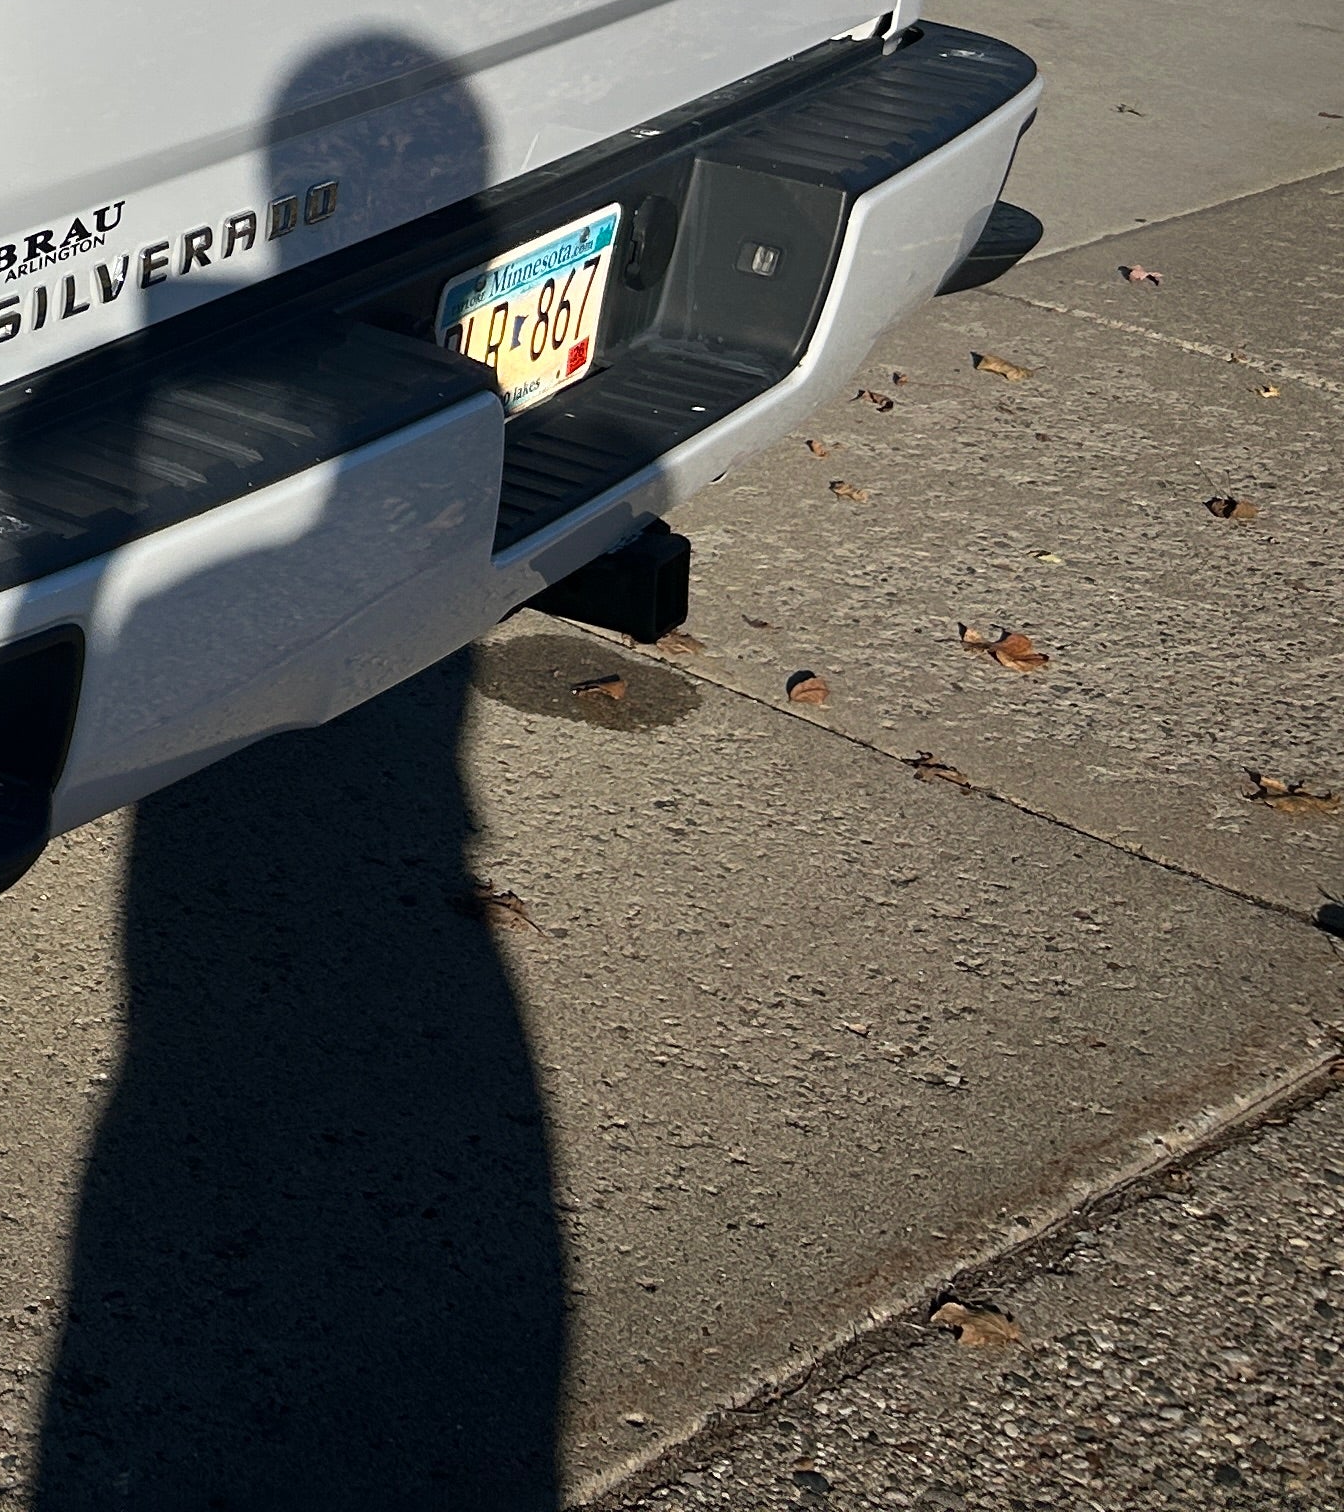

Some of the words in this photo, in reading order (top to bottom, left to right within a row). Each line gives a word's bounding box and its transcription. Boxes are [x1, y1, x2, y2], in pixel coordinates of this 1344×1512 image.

[4, 232, 106, 284] ARLINGTON
[530, 254, 602, 362] 867
[512, 377, 542, 402] lakes
